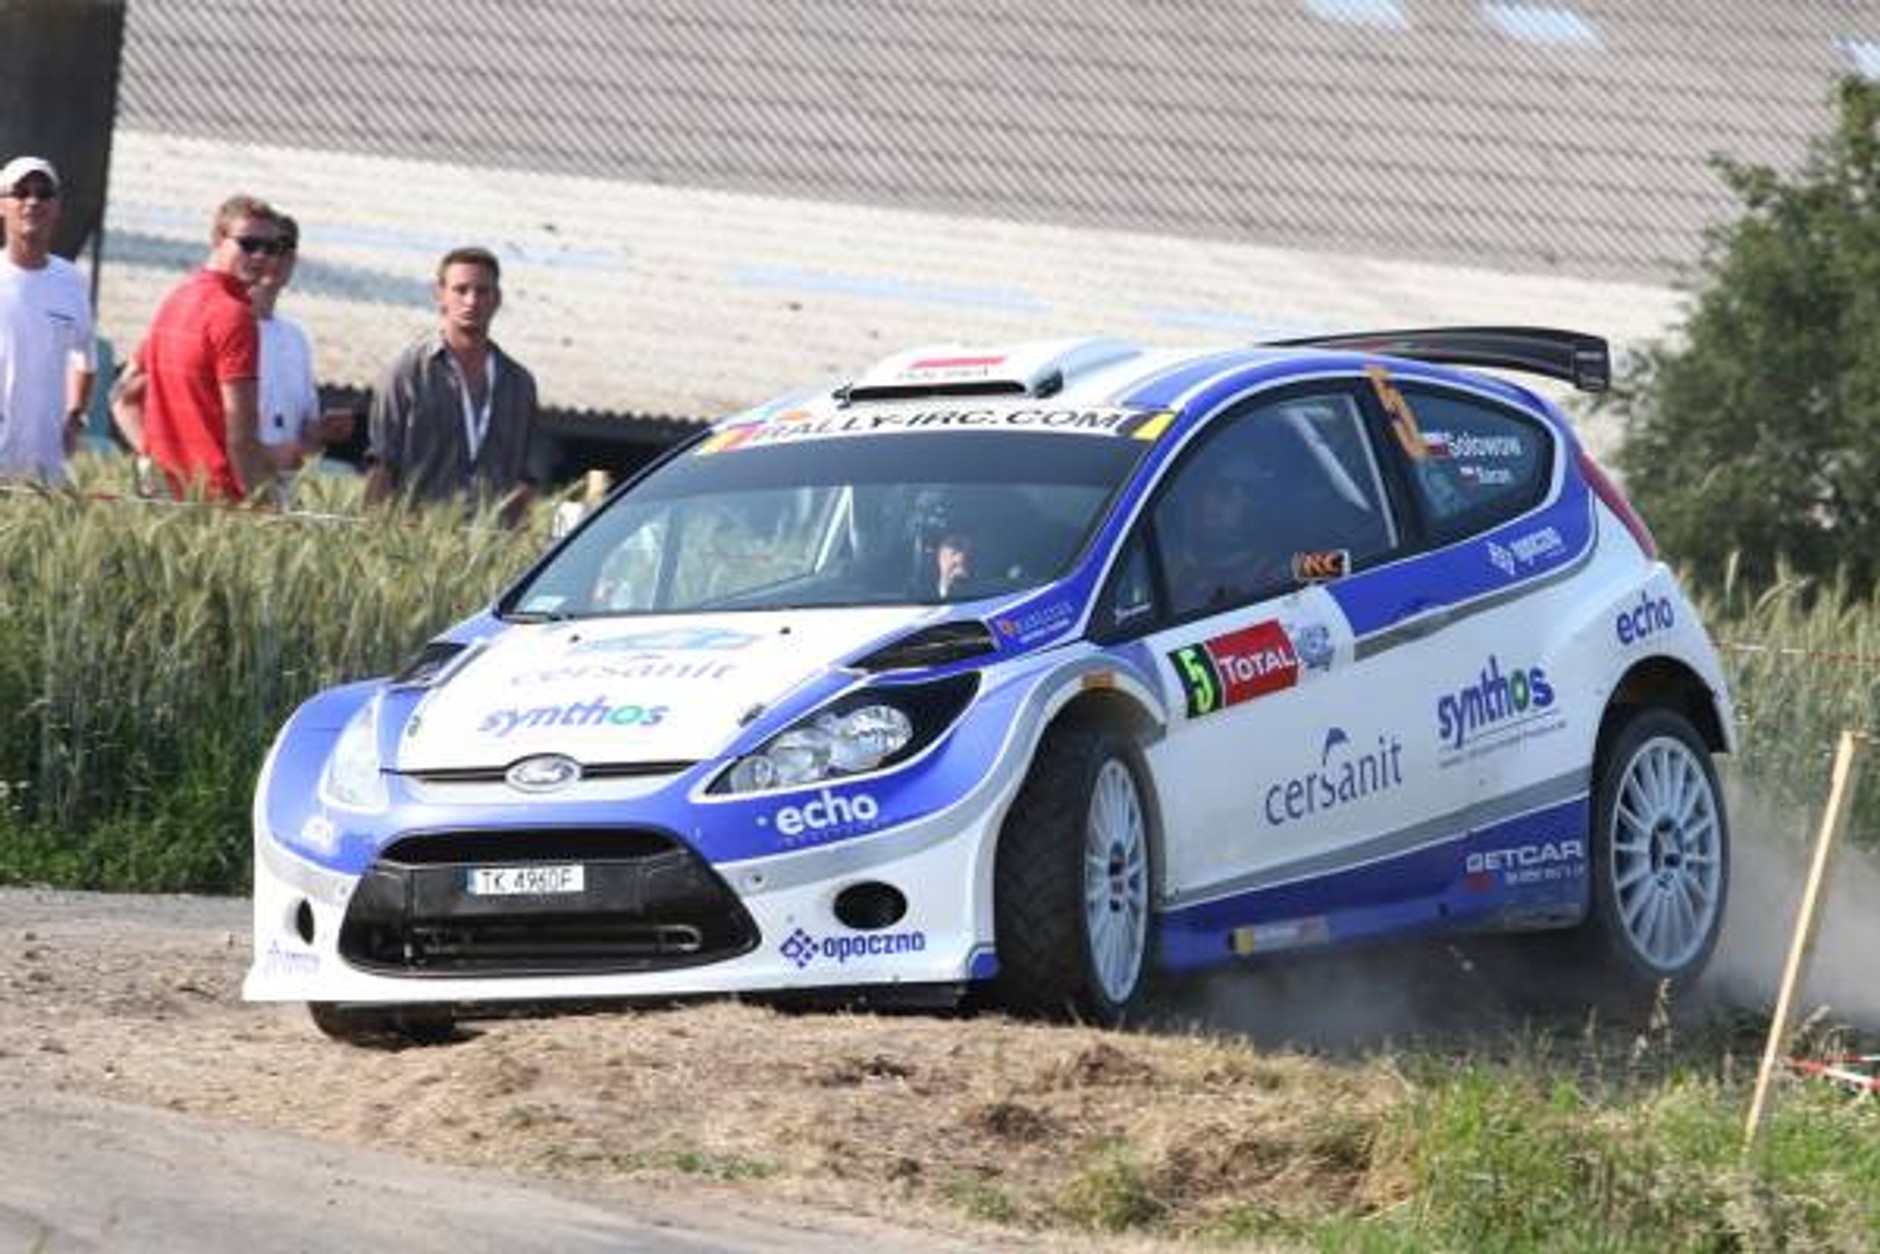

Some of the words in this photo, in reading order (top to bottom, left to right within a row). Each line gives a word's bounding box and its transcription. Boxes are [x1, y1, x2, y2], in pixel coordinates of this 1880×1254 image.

[1617, 589, 1674, 645] echo
[1178, 649, 1214, 713] 5
[1219, 647, 1295, 684] TOTAL
[477, 694, 671, 737] synthos
[1438, 654, 1555, 749] synthos
[1265, 735, 1402, 826] cersanit
[776, 789, 879, 835] echo
[481, 870, 506, 893] TK
[823, 931, 926, 963] opoczno
